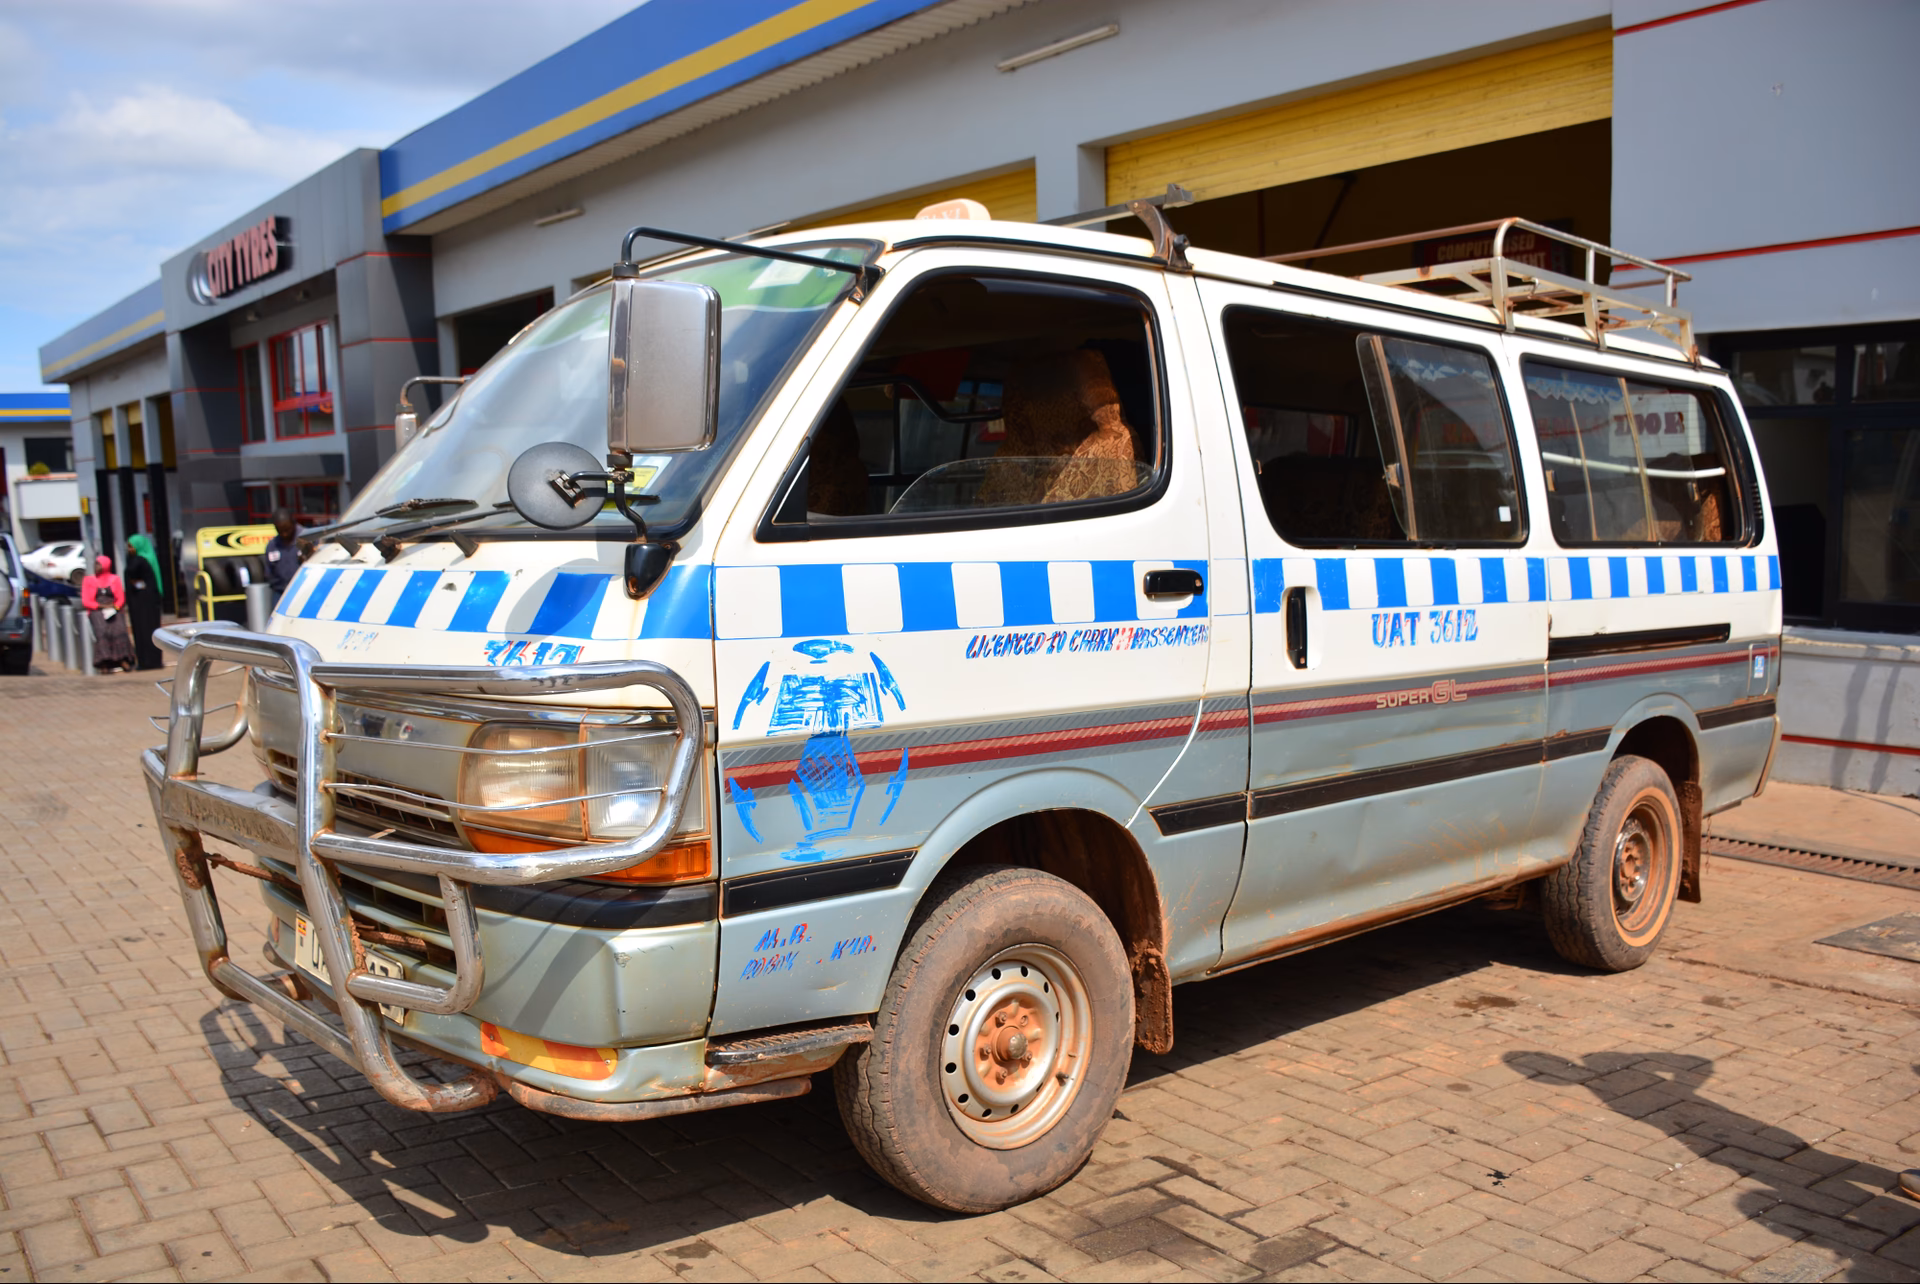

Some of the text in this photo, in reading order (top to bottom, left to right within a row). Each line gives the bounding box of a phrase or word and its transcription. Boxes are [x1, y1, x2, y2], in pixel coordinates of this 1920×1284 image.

[208, 213, 278, 298] CITY TYRES
[1437, 233, 1536, 262] COMPUTISED
[1371, 611, 1421, 648] UAT
[1376, 678, 1468, 709] SUPER GL
